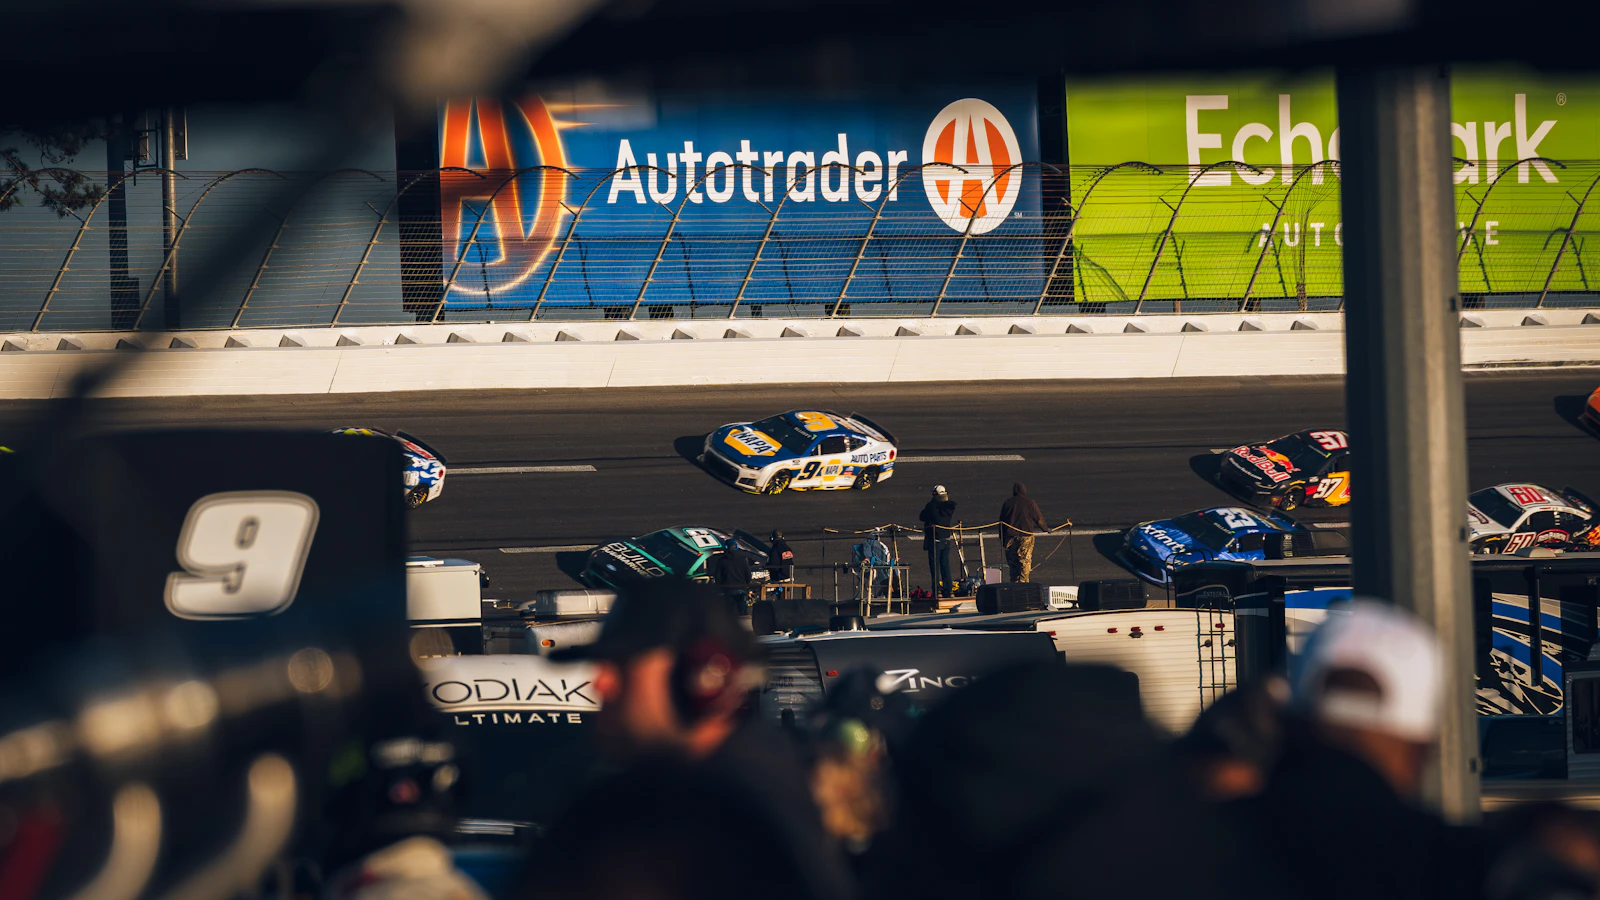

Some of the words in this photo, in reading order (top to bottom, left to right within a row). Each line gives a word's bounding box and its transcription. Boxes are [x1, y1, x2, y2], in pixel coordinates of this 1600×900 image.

[1185, 94, 1560, 188] Echark
[606, 133, 909, 205] Autotrader
[732, 427, 773, 455] NAPA
[823, 464, 841, 475] NAPA
[850, 454, 869, 464] AUTO
[870, 451, 887, 464] PARTS
[1231, 446, 1262, 463] Red
[1255, 457, 1292, 483] Bull
[797, 461, 822, 481] 9
[1312, 478, 1344, 499] 97
[1508, 487, 1548, 505] 60
[1215, 508, 1258, 529] 23
[1140, 524, 1186, 554] xfinity
[1501, 532, 1537, 555] 60
[164, 490, 320, 620] 9
[606, 541, 665, 578] BUILD
[430, 678, 597, 705] ODIAK
[454, 713, 582, 726] LTIMATE
